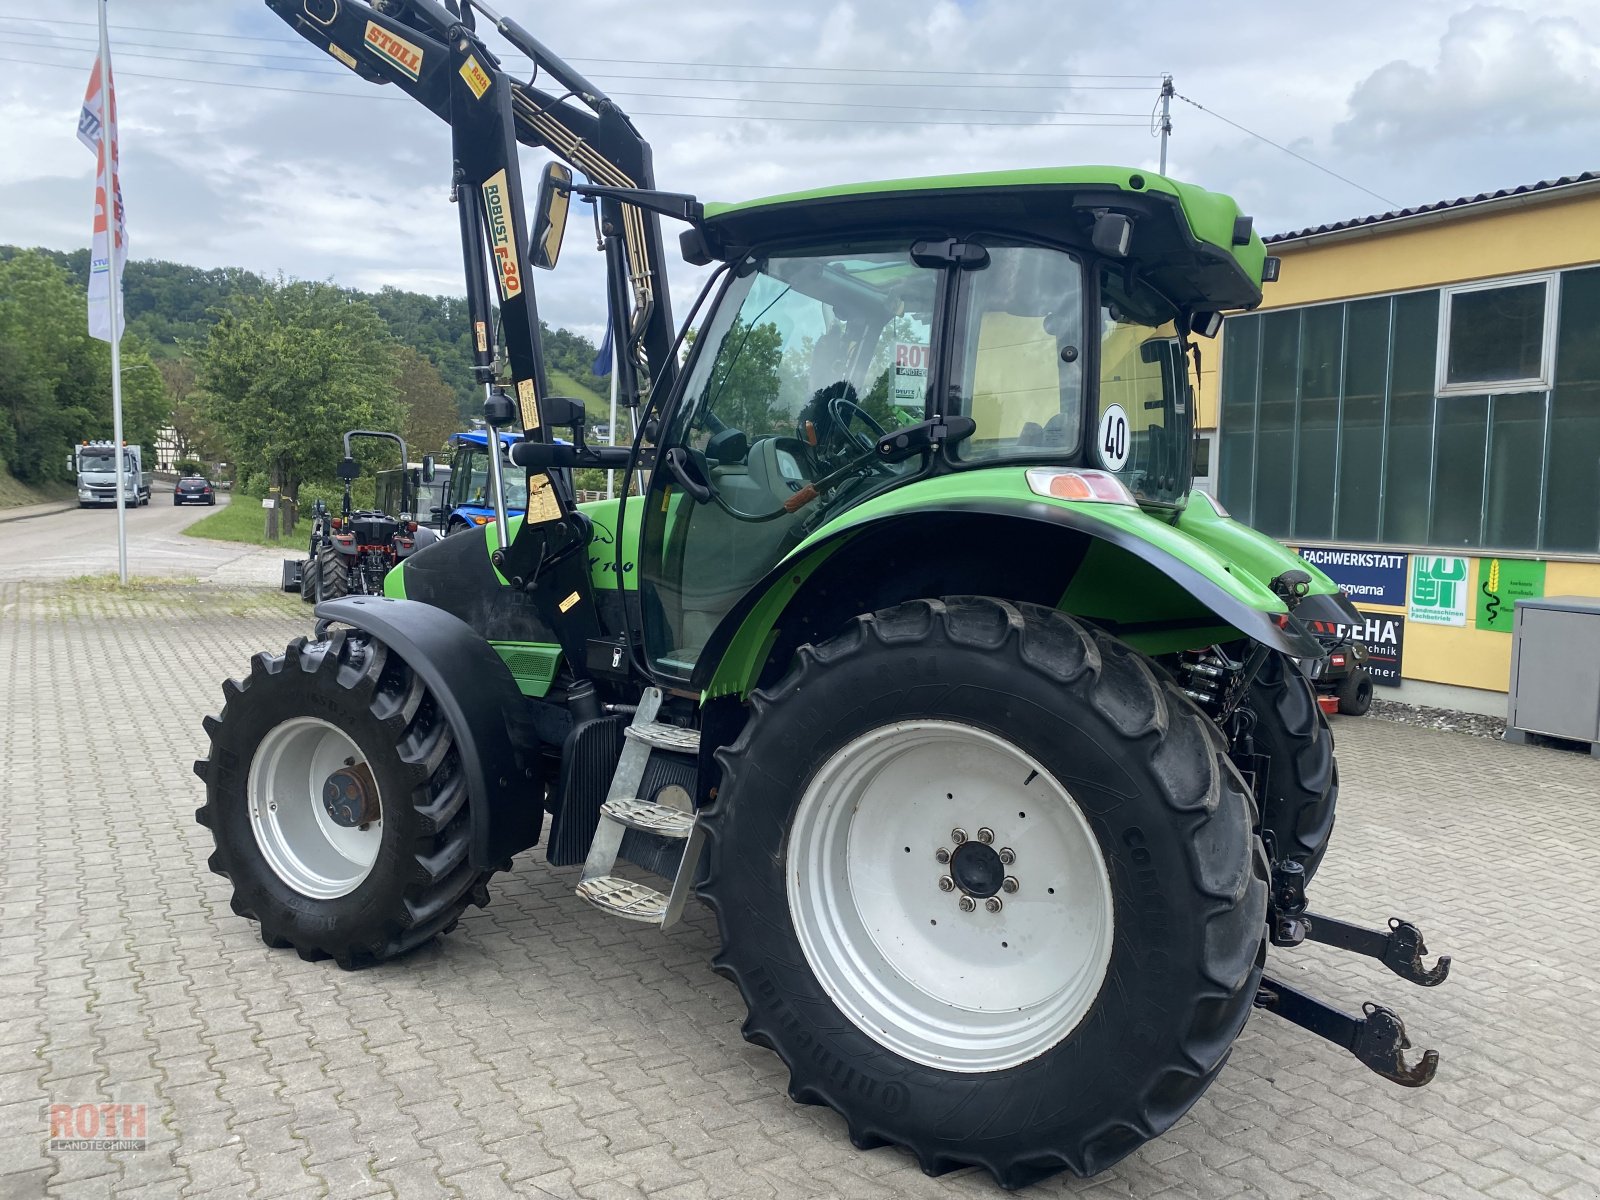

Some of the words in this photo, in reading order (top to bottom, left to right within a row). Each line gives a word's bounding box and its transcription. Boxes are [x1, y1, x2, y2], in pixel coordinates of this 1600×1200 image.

[367, 26, 420, 71] STOLL
[471, 66, 488, 90] Roth
[488, 184, 508, 243] ROBUST
[896, 344, 930, 369] ROT
[1105, 415, 1125, 460] 40
[1303, 550, 1404, 569] FACHWERKSTATT
[1338, 583, 1384, 596] sqvarna
[1410, 612, 1451, 622] Fachbetrieb
[1411, 606, 1464, 617] Landmaschinen
